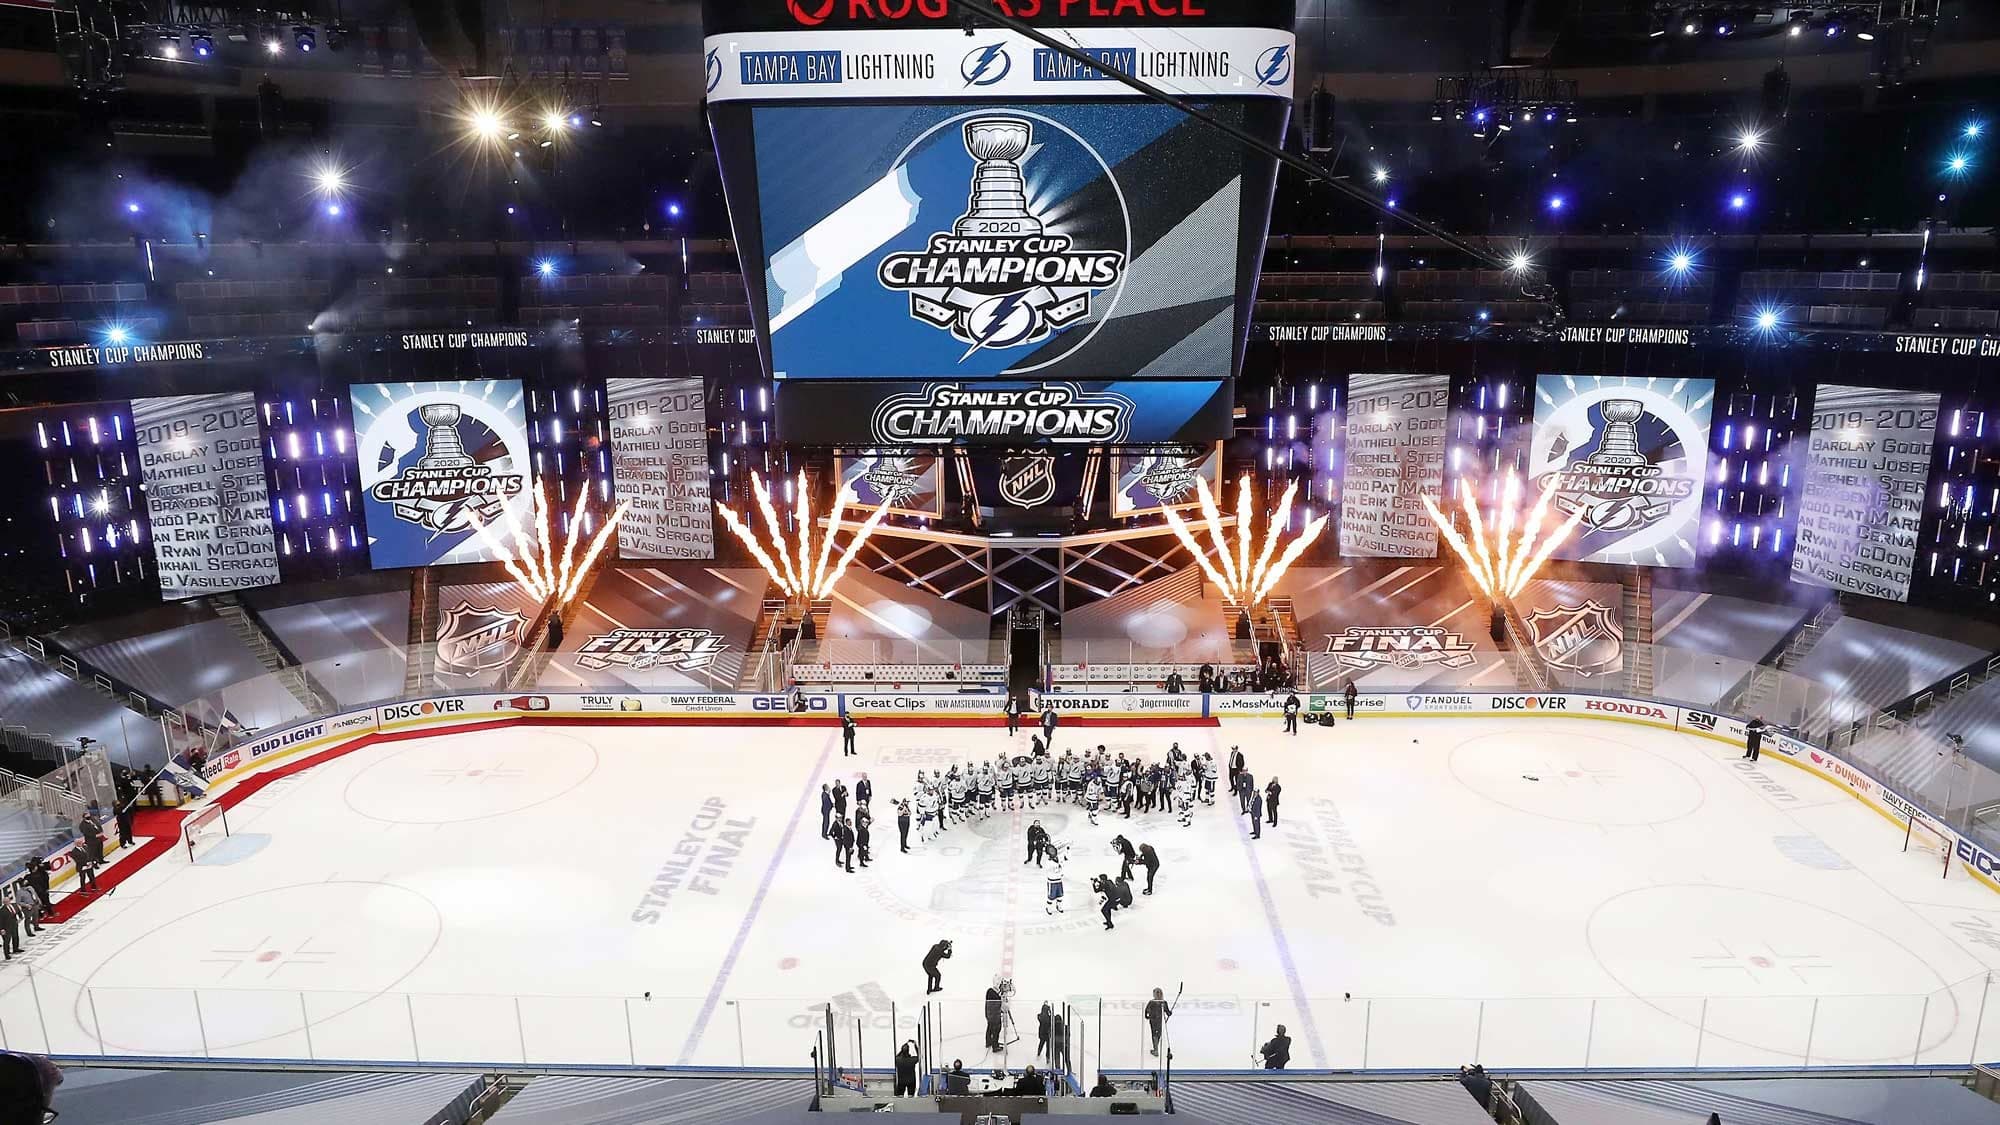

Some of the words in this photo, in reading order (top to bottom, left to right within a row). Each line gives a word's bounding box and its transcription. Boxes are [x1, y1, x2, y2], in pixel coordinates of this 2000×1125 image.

[848, 0, 1040, 20] ROGRS
[744, 55, 799, 81] TAMPA
[807, 55, 837, 81] BAY
[846, 54, 934, 80] LIGHTNING
[1038, 52, 1093, 79] TAMPA
[1101, 51, 1130, 78] BAY
[1140, 51, 1229, 77] LIGHTNING
[978, 222, 1021, 233] 2020
[933, 237, 1022, 254] STANLEY
[1023, 237, 1067, 252] CUP
[883, 256, 1117, 284] CHAMPIONS
[402, 334, 444, 349] STANLEY
[448, 333, 467, 348] CUP
[470, 332, 527, 348] CHAMPIONS
[697, 329, 735, 344] STANLEY
[738, 329, 756, 344] CUP
[1269, 326, 1308, 341] STANLEY
[1311, 326, 1329, 341] CUP
[1332, 326, 1386, 341] CHAMPIONS
[1560, 327, 1603, 342] STANLEY
[1605, 328, 1625, 343] CUP
[1628, 328, 1689, 344] CHAMPIONS
[1895, 336, 1948, 354] STANLEY
[1952, 338, 1977, 355] CUP
[50, 348, 100, 367] STANLEY
[105, 346, 129, 363] CUP
[134, 343, 203, 362] CHAMPIONS
[935, 390, 1023, 407] STANLEY
[1025, 390, 1067, 406] CUP
[889, 408, 1115, 435] CHAMPIONS
[1349, 422, 1402, 435] BARCLAY
[613, 425, 663, 438] BARCLAY
[612, 441, 660, 452] MATHIEU
[1346, 437, 1396, 449] MATHIEU
[1813, 438, 1876, 452] BARCLAY
[144, 446, 208, 466] BARCLAY
[434, 459, 460, 467] 2020
[1604, 456, 1632, 464] 2020
[1808, 454, 1868, 469] MATHIEU
[143, 463, 206, 482] MATHIEU
[405, 469, 462, 480] STANLEY
[462, 467, 490, 477] CUP
[1141, 471, 1193, 484] CHAMPIONS
[1574, 464, 1630, 476] STANLEY
[1632, 466, 1660, 477] CUP
[376, 476, 522, 498] CHAMPIONS
[864, 474, 914, 486] CHAMPIONS
[1011, 464, 1044, 496] NHL
[1372, 480, 1397, 493] PAT
[1541, 472, 1693, 495] CHAMPIONS
[146, 480, 216, 498] MITCHELL
[642, 484, 666, 496] PAT
[151, 496, 219, 511] BRAYDEN
[632, 496, 659, 510] ERIK
[664, 499, 711, 512] CERNA
[1360, 494, 1387, 507] ERIK
[187, 512, 217, 525] PAT
[623, 511, 651, 524] RYAN
[1347, 507, 1377, 521] RYAN
[1833, 504, 1865, 521] PAT
[176, 529, 209, 542] ERIK
[216, 525, 273, 538] CERNA
[1802, 529, 1837, 549] RYAN
[162, 545, 200, 557] RYAN
[632, 537, 710, 559] VASILEVSKIY
[1354, 535, 1434, 558] VASILEVSKIY
[177, 574, 276, 587] VASILEVSKIY
[1808, 561, 1904, 602] VASILEVSKIY
[612, 630, 674, 638] STANLEY
[676, 630, 707, 638] CUP
[1413, 628, 1444, 636] CUP
[1547, 619, 1597, 659] NHL
[452, 624, 514, 660] NHL
[582, 638, 721, 653] FINAL
[1332, 635, 1471, 650] FINAL
[580, 696, 613, 704] TRULY
[670, 696, 696, 704] NAVY
[697, 696, 736, 704] FEDERAL
[752, 697, 828, 711] GEO
[852, 697, 892, 709] Great
[894, 697, 926, 711] Clips
[935, 700, 949, 708] NEW
[950, 700, 990, 708] AMSTERDAM
[991, 700, 1006, 708] VOD
[1036, 697, 1109, 709] GATORADE
[1232, 699, 1287, 709] MassMutu
[1313, 699, 1384, 710] enteprise
[1425, 696, 1472, 704] FANDUEL
[1491, 696, 1566, 710] DISCOVER
[384, 699, 464, 720] DISCOVER
[1585, 700, 1668, 719] HONDA
[1687, 711, 1717, 726] SN
[251, 738, 281, 756] BUD
[282, 725, 324, 745] LIGHT
[1729, 726, 1743, 736] THE
[1762, 735, 1776, 745] RUN
[1780, 740, 1800, 754] SAP
[1834, 763, 1872, 792] DUNKIN'
[1882, 789, 1904, 807] NAVY
[632, 832, 706, 924] STANLEY
[691, 797, 728, 831] CUP
[688, 817, 759, 895] FINAL
[1279, 818, 1342, 900] FINAL
[1310, 798, 1375, 880] STANLEY
[1351, 880, 1397, 926] CUP
[788, 1014, 916, 1029] adidas
